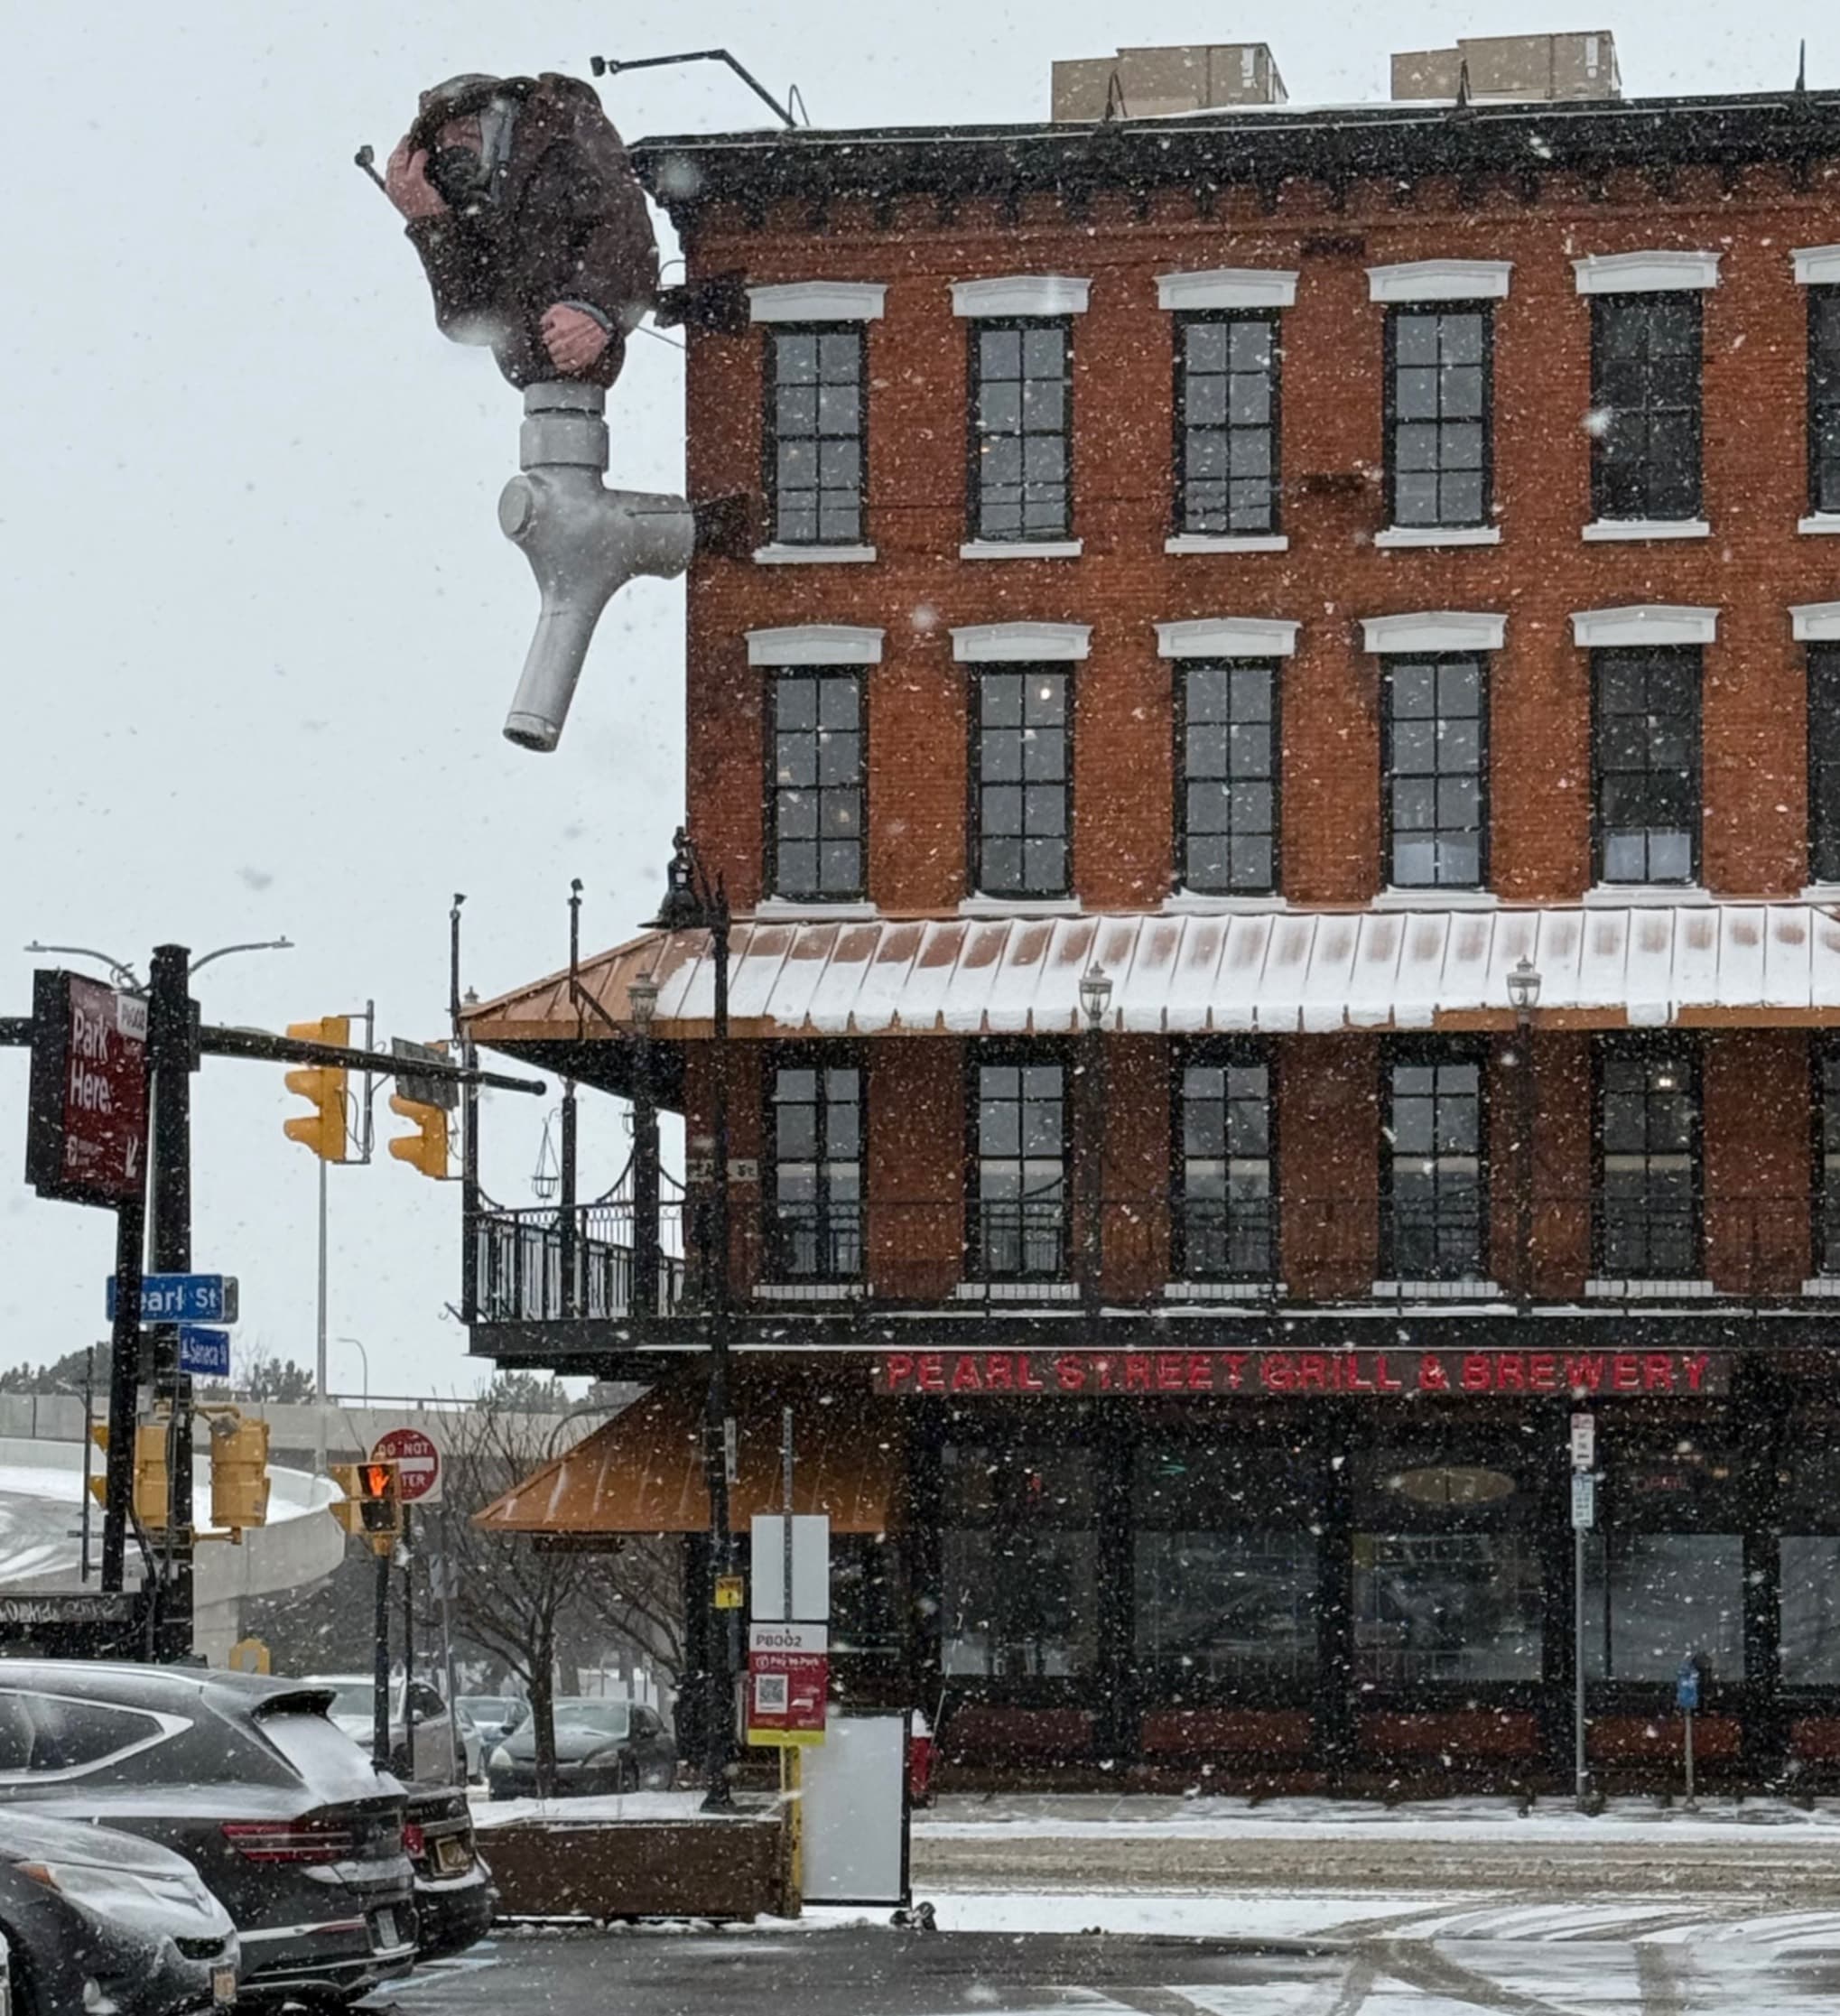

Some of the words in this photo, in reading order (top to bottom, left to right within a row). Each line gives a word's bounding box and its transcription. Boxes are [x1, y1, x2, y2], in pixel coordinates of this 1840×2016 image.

[72, 1007, 109, 1063] Park
[140, 1285, 183, 1312] arl
[195, 1287, 217, 1308] St
[887, 1354, 1044, 1390] PEARL
[1055, 1354, 1249, 1390] STREET
[1259, 1354, 1403, 1390] GRILL
[1418, 1354, 1450, 1390] &
[1461, 1354, 1710, 1390] BREWERY
[378, 1443, 396, 1456] DO
[404, 1442, 430, 1455] NOT
[401, 1473, 426, 1488] TER
[756, 1633, 802, 1647] P8002
